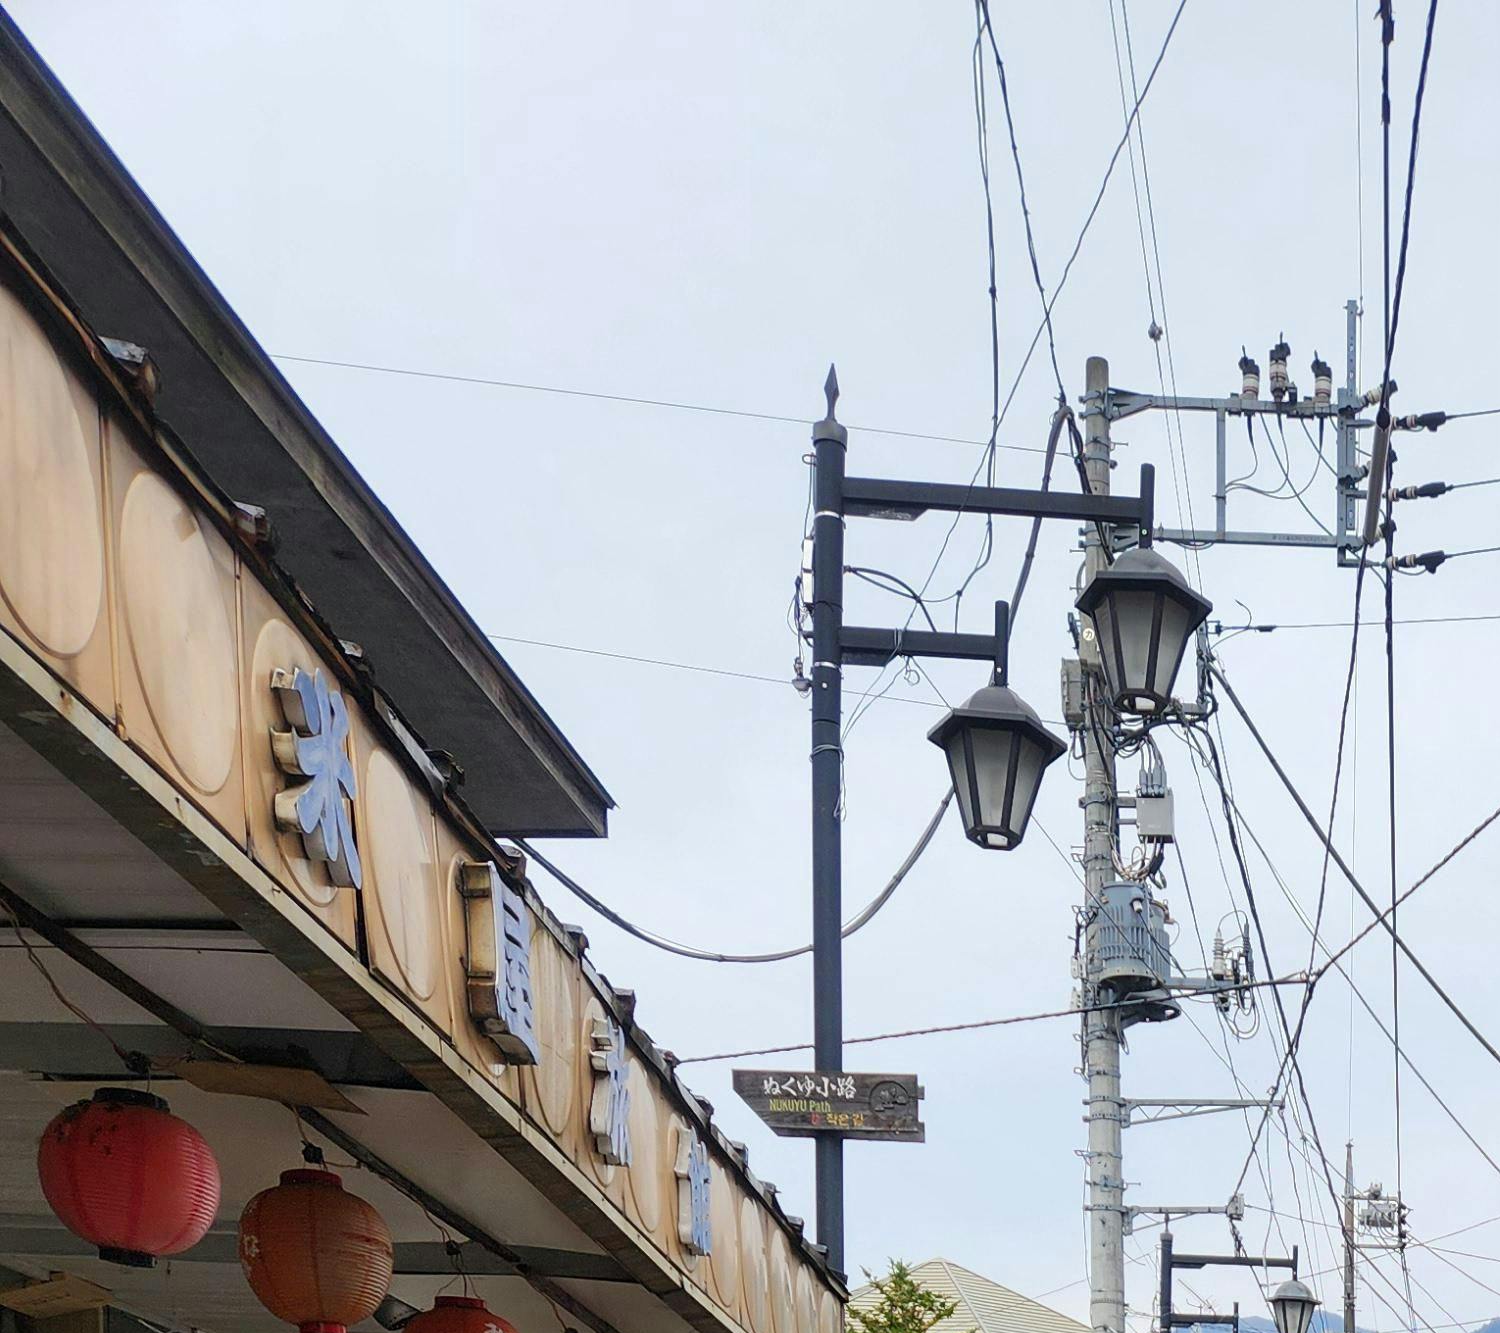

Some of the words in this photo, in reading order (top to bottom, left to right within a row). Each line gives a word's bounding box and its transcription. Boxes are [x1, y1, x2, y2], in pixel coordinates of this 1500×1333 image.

[763, 1075, 857, 1099] ぬくゆ小路
[769, 1099, 807, 1112] NUKUYU
[809, 1099, 831, 1112] Path
